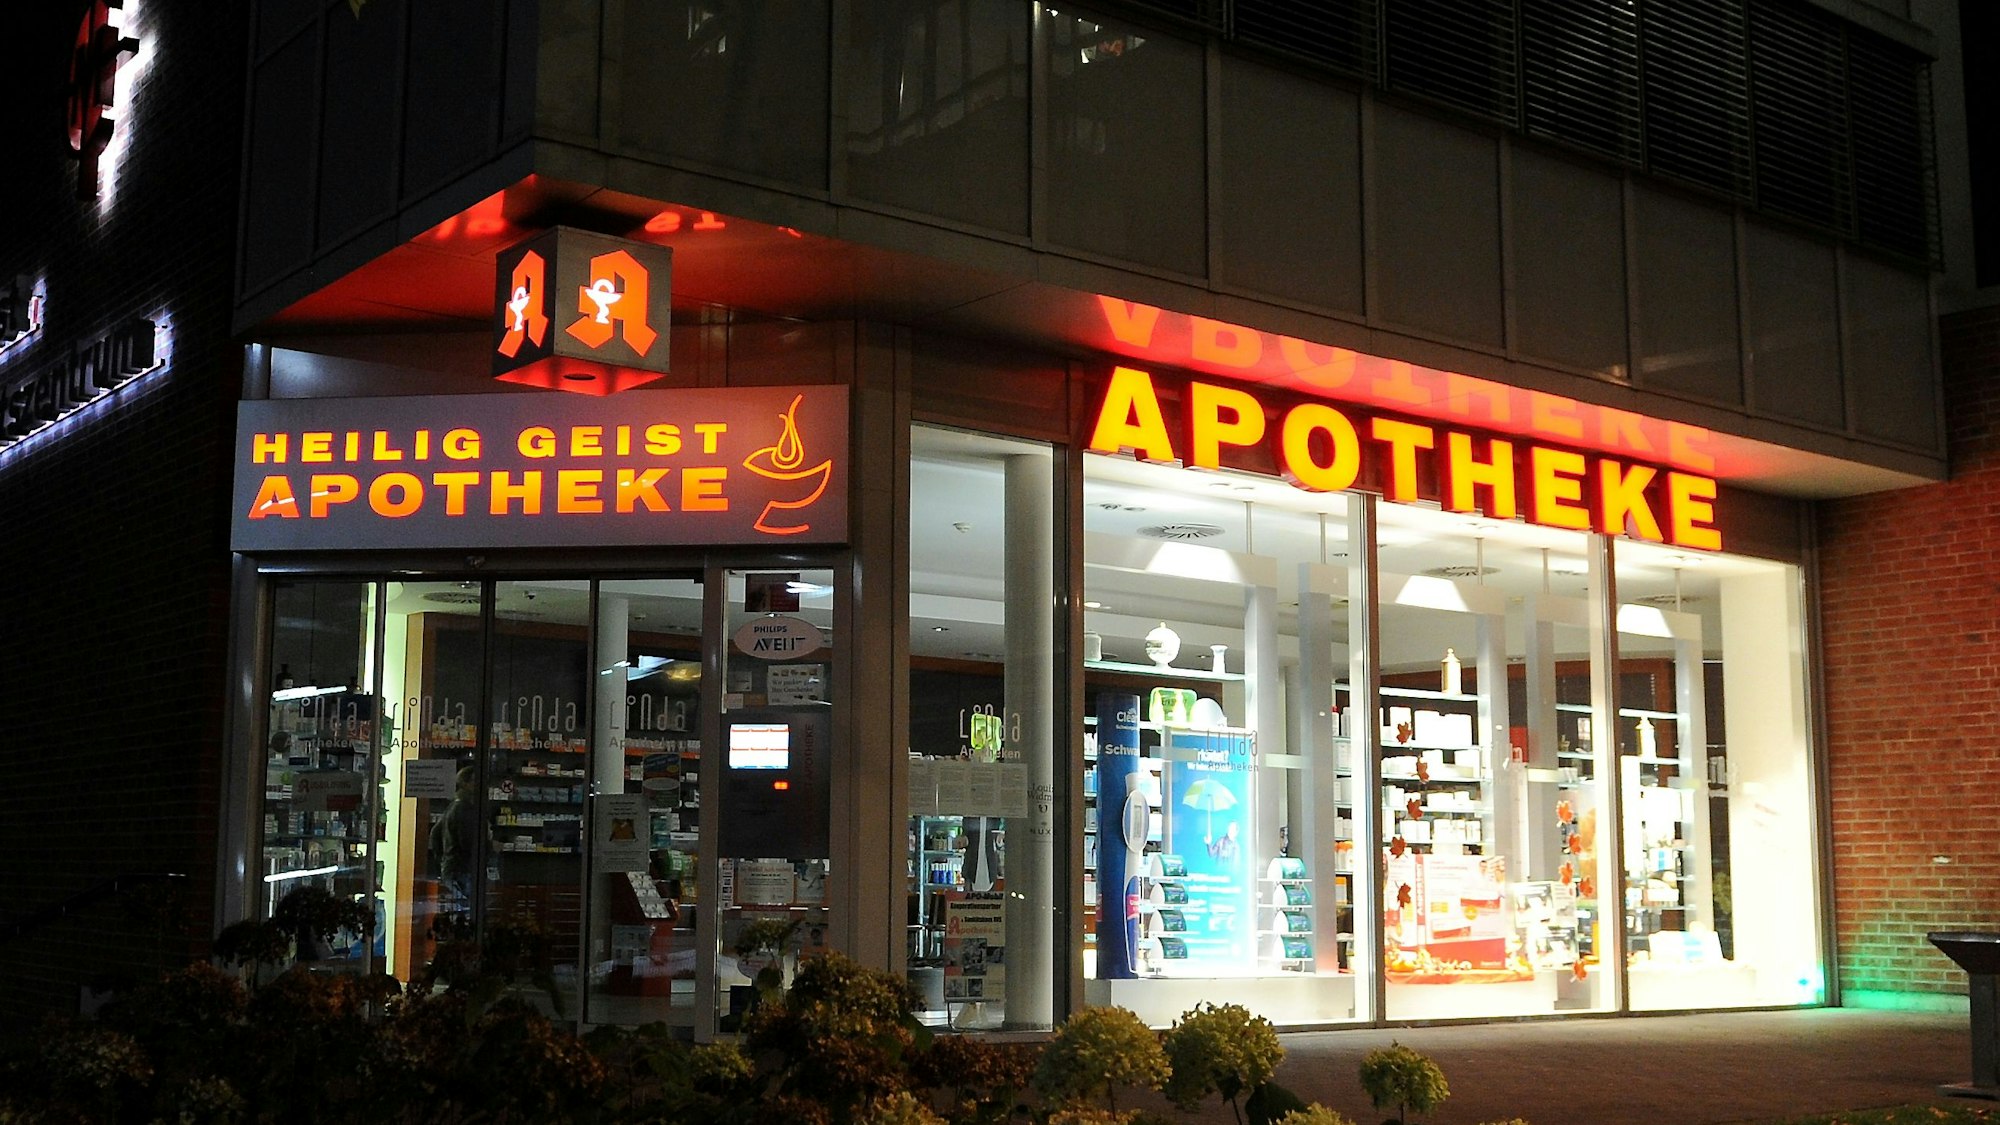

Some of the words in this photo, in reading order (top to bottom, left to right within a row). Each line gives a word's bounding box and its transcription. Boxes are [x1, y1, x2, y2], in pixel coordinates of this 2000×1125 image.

[252, 428, 482, 464] HEILIG
[517, 423, 728, 458] GEIST
[1087, 365, 1723, 552] APOTHEKE
[247, 466, 729, 519] APOTHEKE
[754, 625, 787, 633] PHILIPS
[300, 696, 358, 731] inda
[959, 744, 1021, 761] Apheken
